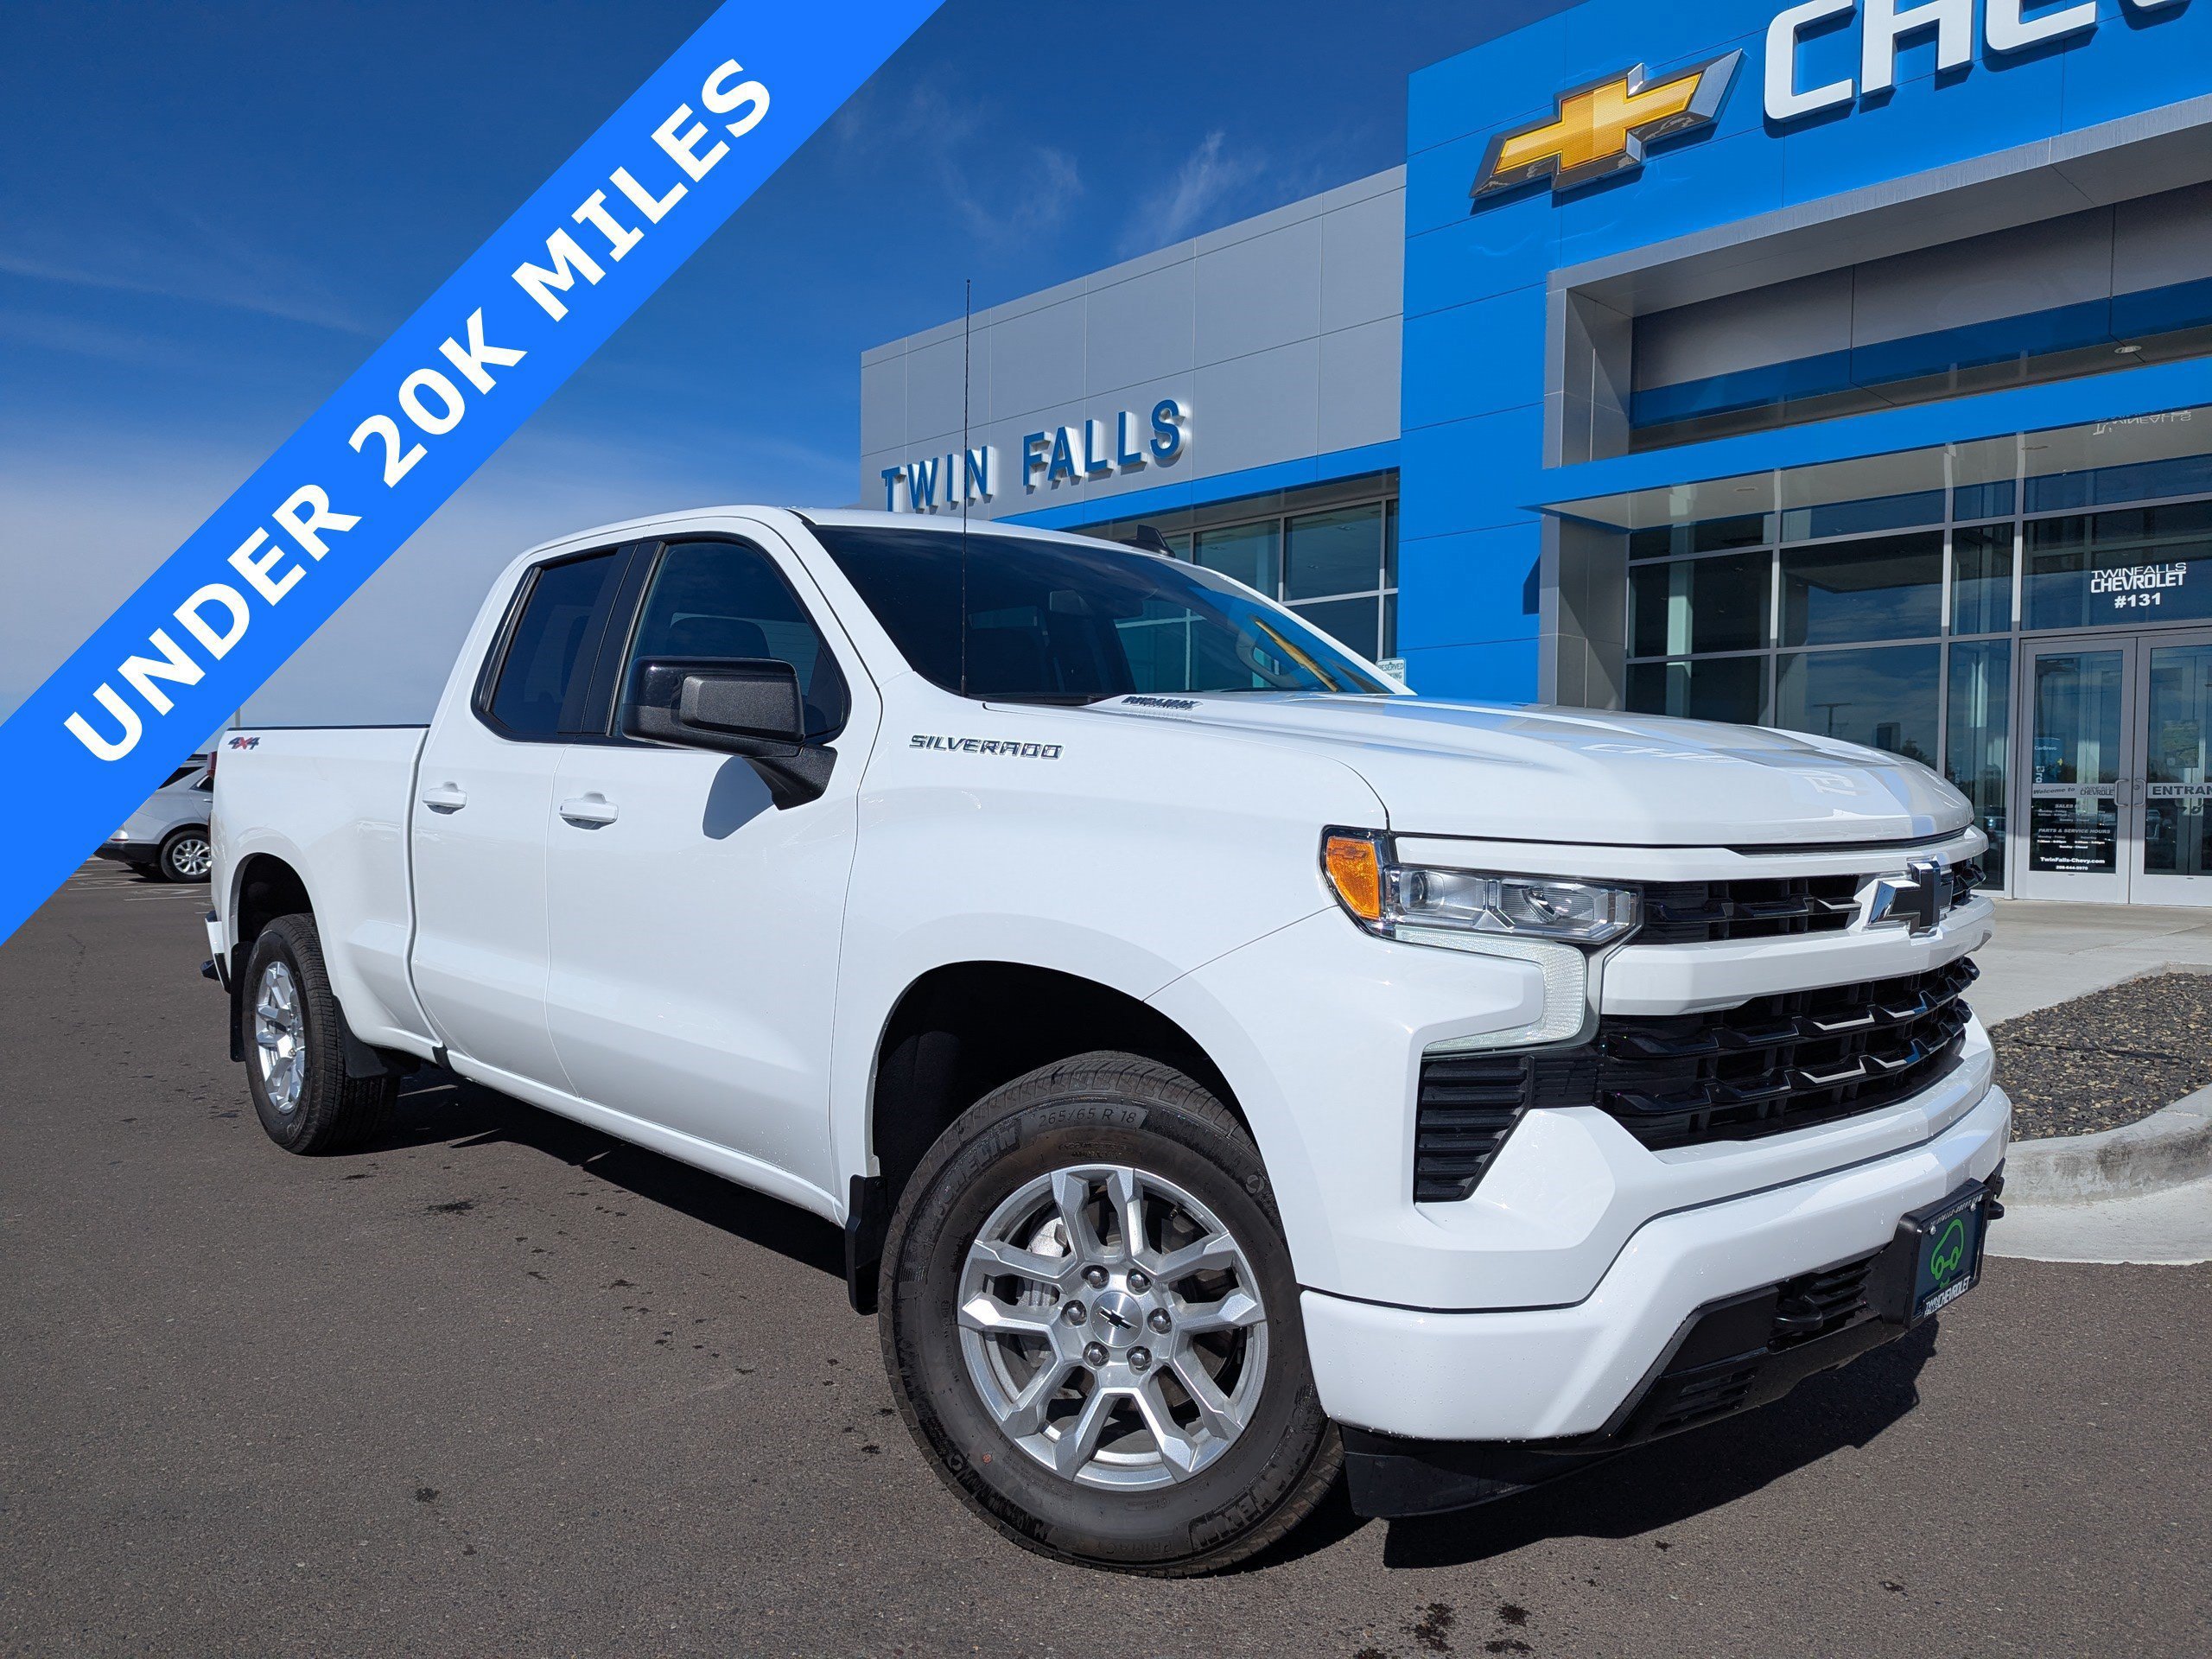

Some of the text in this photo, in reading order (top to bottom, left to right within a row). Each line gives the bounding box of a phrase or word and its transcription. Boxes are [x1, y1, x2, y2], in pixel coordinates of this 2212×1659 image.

[1764, 0, 2186, 119] CH
[881, 398, 1186, 512] TWIN FALLS
[2091, 562, 2187, 580] TWINFALLS
[2091, 570, 2187, 594] CHEVROLET
[2114, 592, 2161, 608] #131
[910, 734, 1064, 760] SILVERADO
[1102, 1109, 1115, 1121] R
[1120, 1110, 1137, 1123] 18
[1937, 1275, 1971, 1308] CHEVROLET
